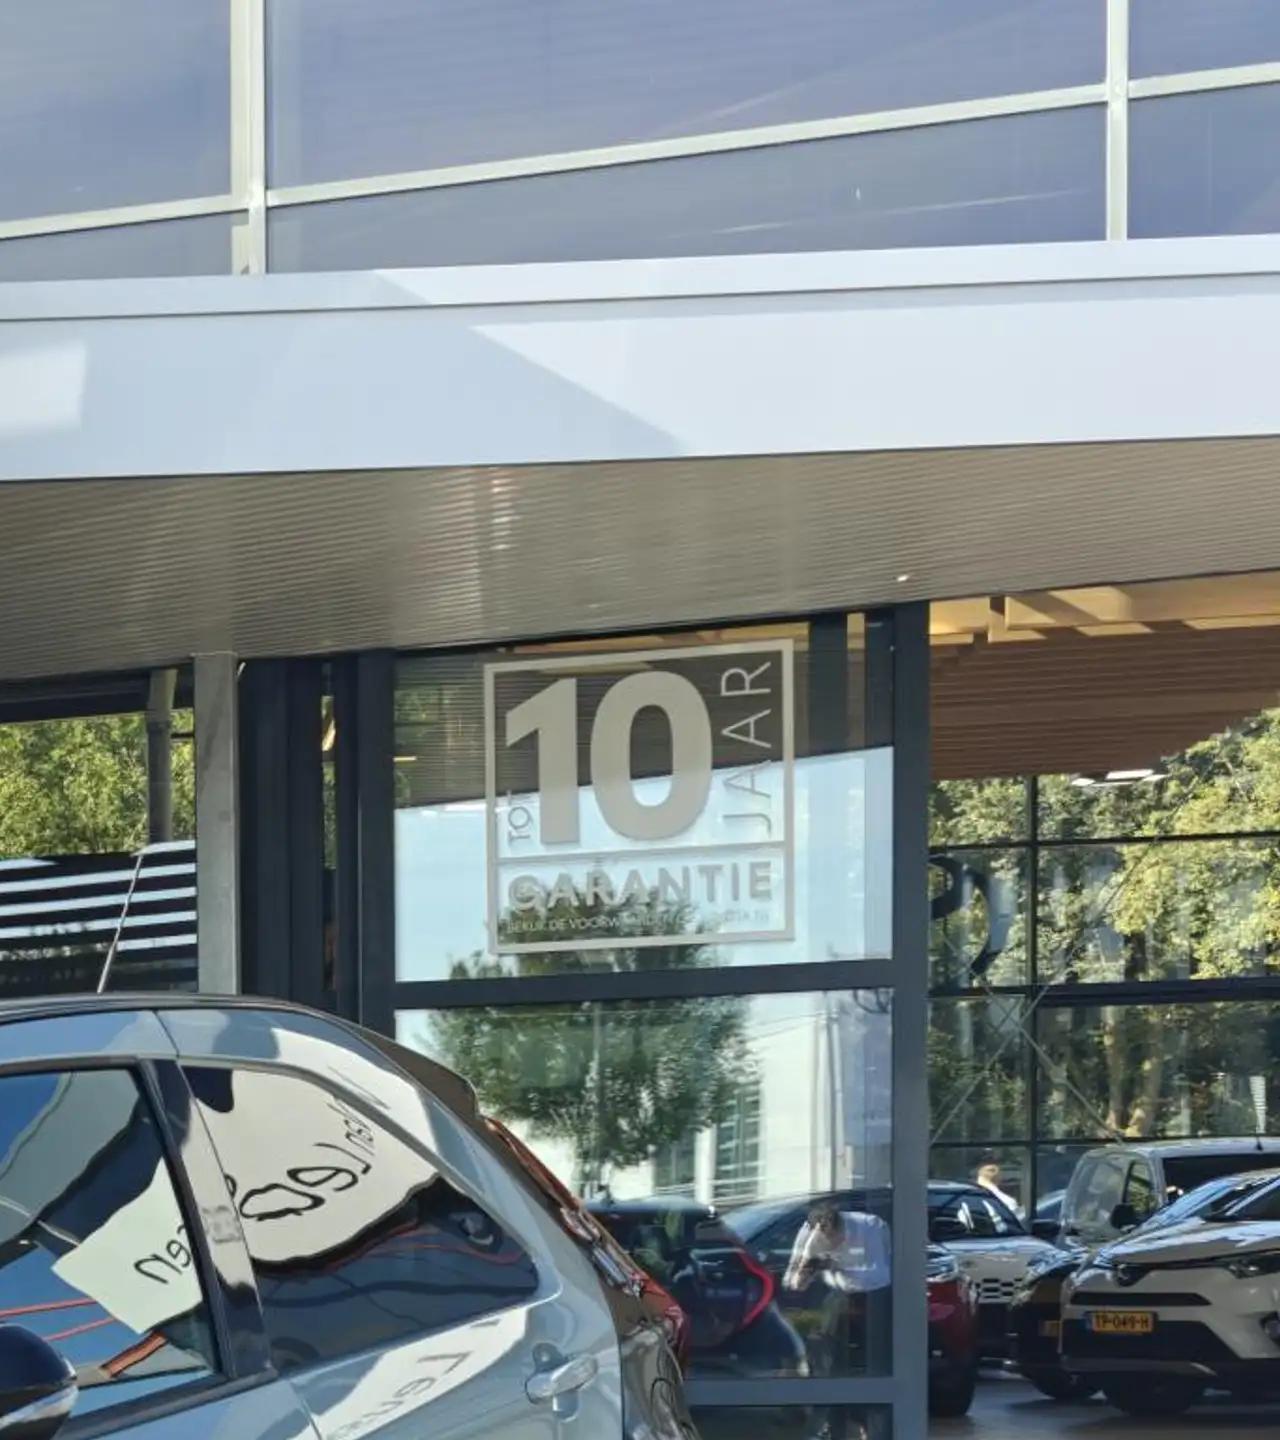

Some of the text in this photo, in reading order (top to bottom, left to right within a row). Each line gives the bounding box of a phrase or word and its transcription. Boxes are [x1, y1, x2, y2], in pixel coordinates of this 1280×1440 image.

[505, 670, 713, 845] 10
[719, 661, 772, 837] JAAR
[507, 860, 773, 911] GARANTIE
